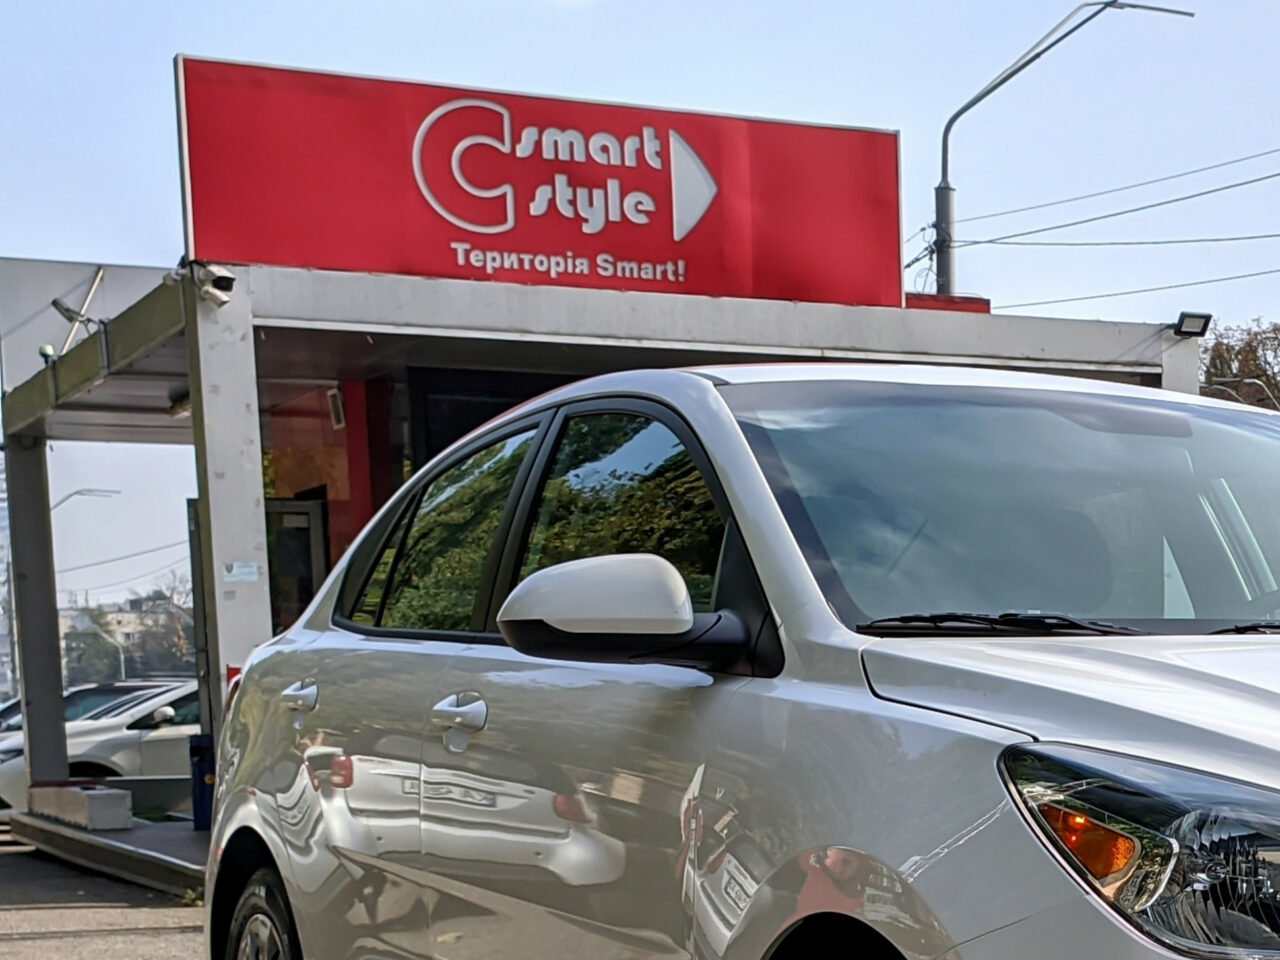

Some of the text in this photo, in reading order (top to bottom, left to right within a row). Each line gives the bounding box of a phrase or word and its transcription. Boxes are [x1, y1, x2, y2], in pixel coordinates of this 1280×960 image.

[515, 126, 662, 170] smart
[529, 173, 656, 234] style
[450, 242, 686, 281] Територія Smart!
